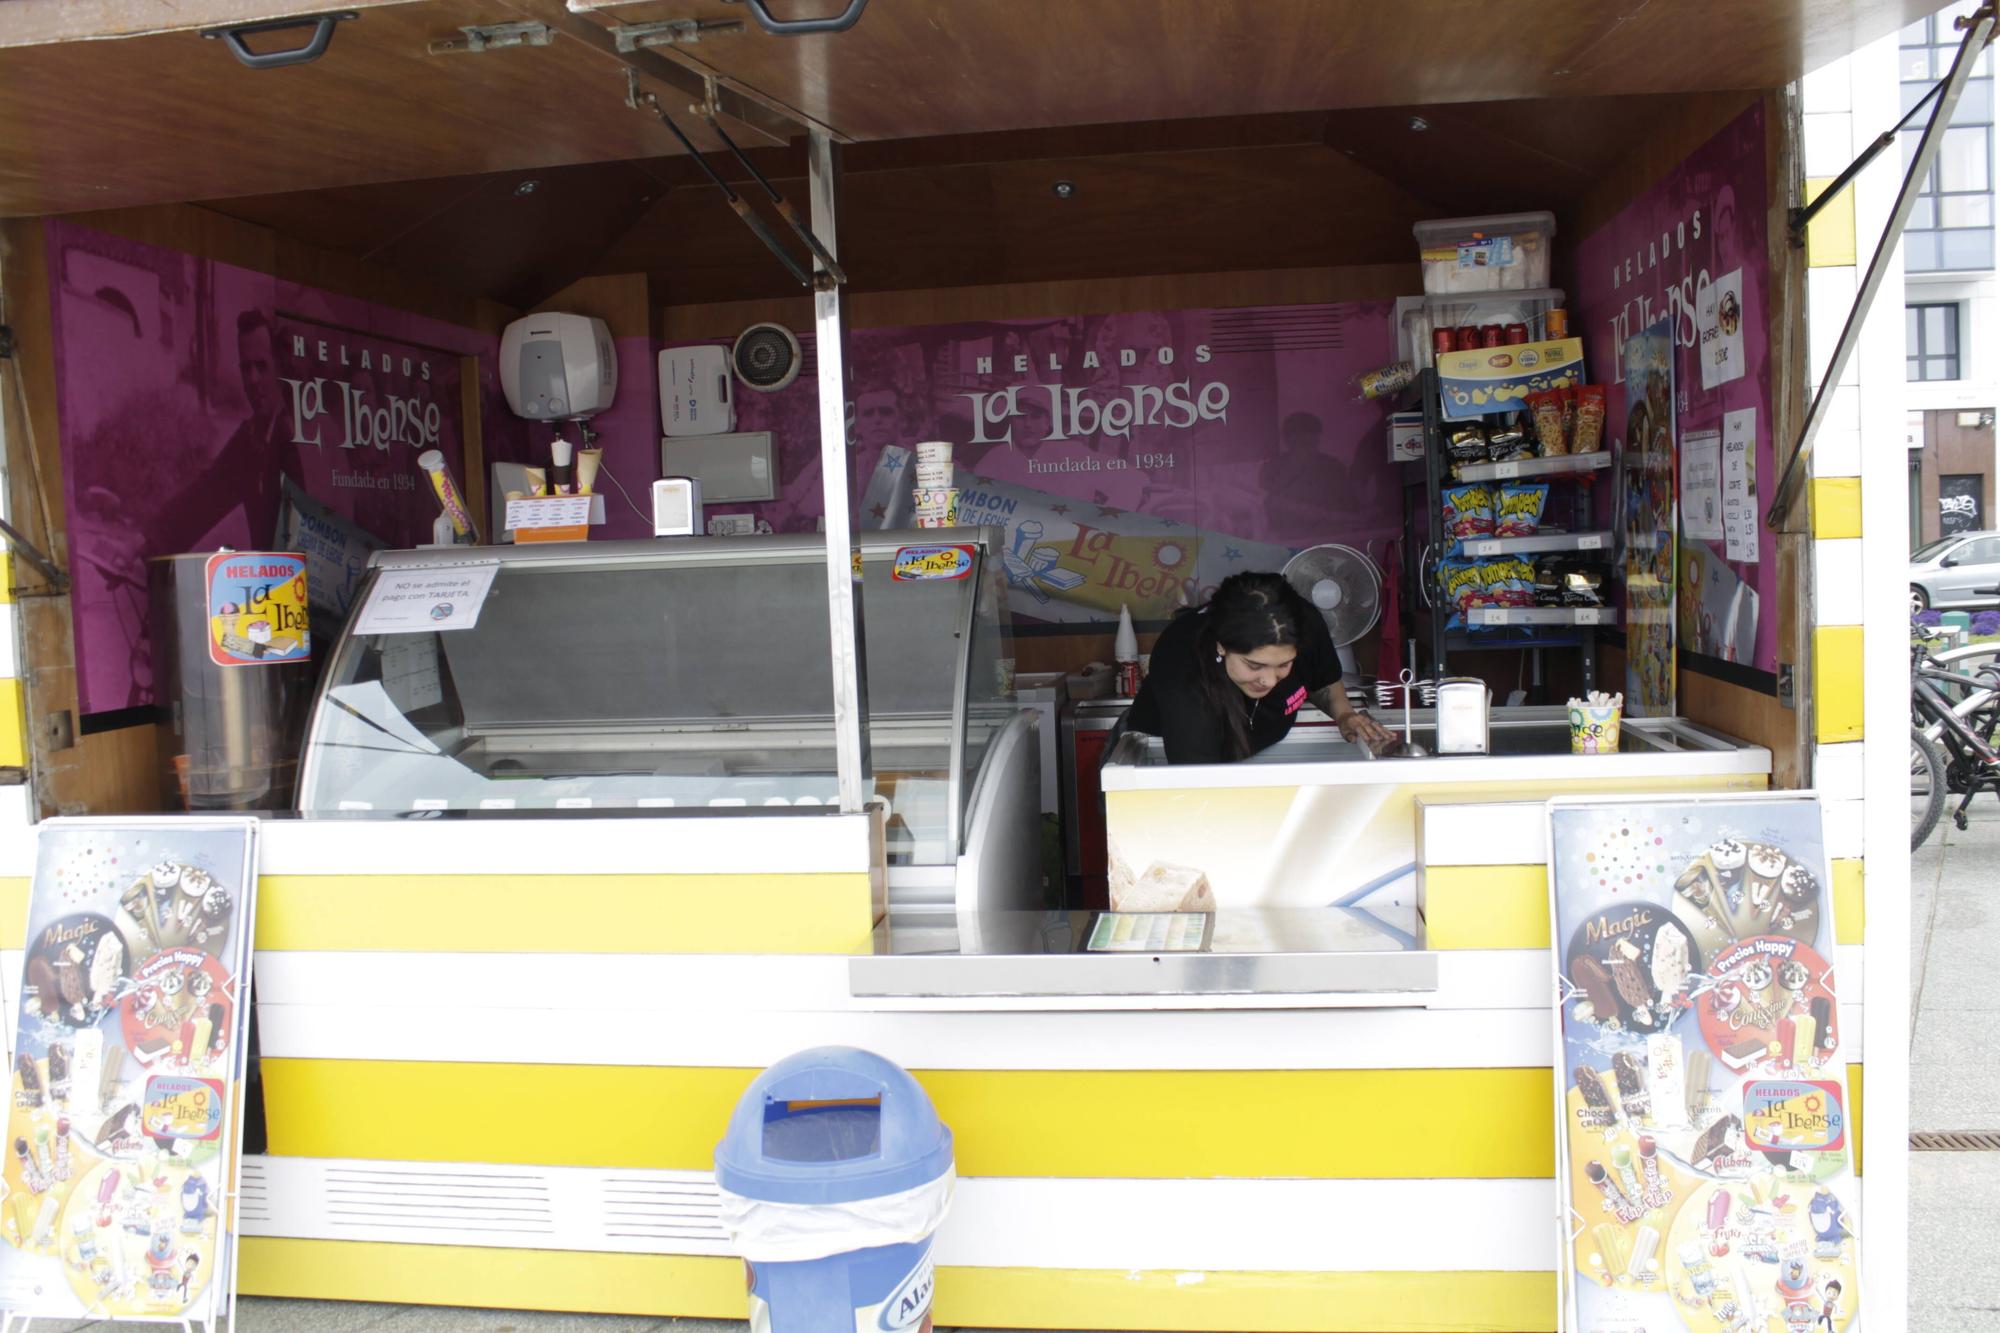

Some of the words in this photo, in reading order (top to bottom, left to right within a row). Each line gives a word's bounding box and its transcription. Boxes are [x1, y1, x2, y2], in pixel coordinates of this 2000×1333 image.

[1614, 210, 1701, 290] HELADOS
[293, 335, 430, 381] HELADOS
[976, 344, 1212, 375] HELADOS
[278, 377, 328, 453] La
[333, 380, 440, 455] Ibense
[954, 386, 1027, 451] La
[1037, 376, 1230, 441] Ibense
[1028, 456, 1101, 474] Fundada
[1107, 458, 1127, 470] en
[1135, 453, 1175, 469] 1934
[332, 469, 375, 488] Fundada
[377, 476, 390, 490] en
[393, 474, 416, 490] 1934
[960, 489, 1018, 515] MBON
[1066, 522, 1120, 566] La
[225, 565, 295, 579] HELADOS
[926, 559, 970, 570] Ibense
[425, 579, 459, 588] admite
[236, 583, 273, 615] La
[382, 594, 408, 603] pago
[44, 918, 99, 948] Magic
[1585, 908, 1653, 945] Magic
[1717, 946, 1754, 972] Precios
[1755, 940, 1794, 957] Happy
[1755, 1088, 1801, 1097] HELADOS
[177, 1105, 220, 1122] Ibense
[1784, 1112, 1841, 1130] Ibense
